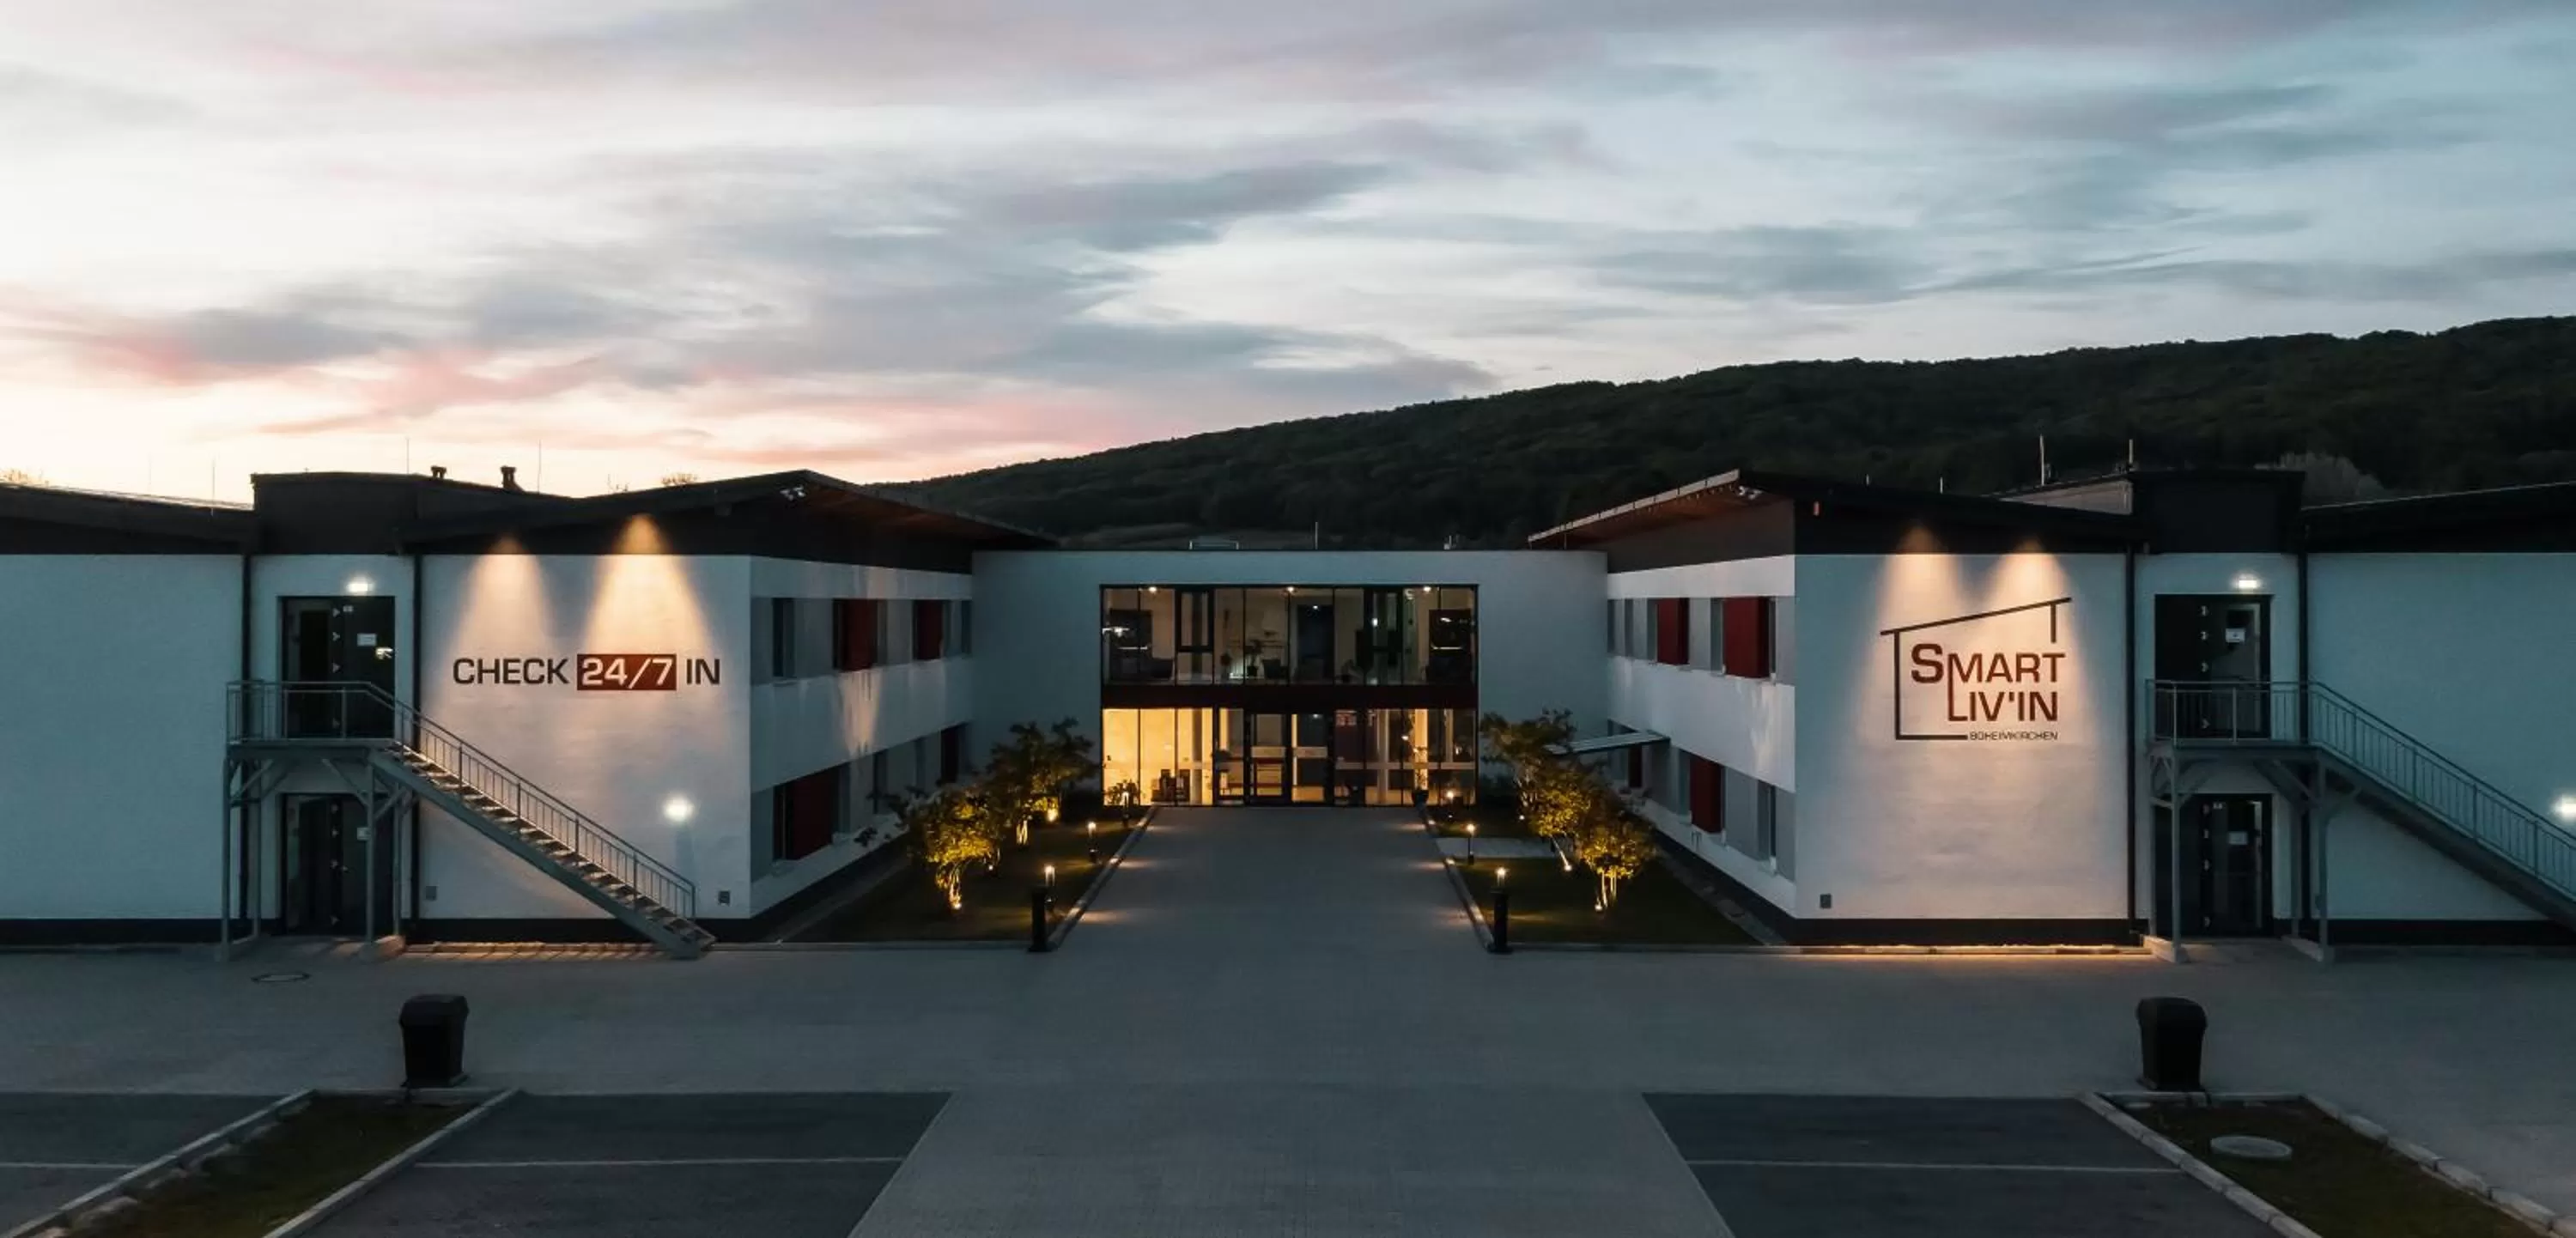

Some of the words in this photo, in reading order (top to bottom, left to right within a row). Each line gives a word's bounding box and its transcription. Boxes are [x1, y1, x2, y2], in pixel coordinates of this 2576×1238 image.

[453, 658, 569, 684] CHECK
[582, 658, 673, 689] 24/7
[687, 658, 720, 684] IN
[1911, 643, 2065, 683] SMART
[1947, 689, 2057, 722] LIV'IN
